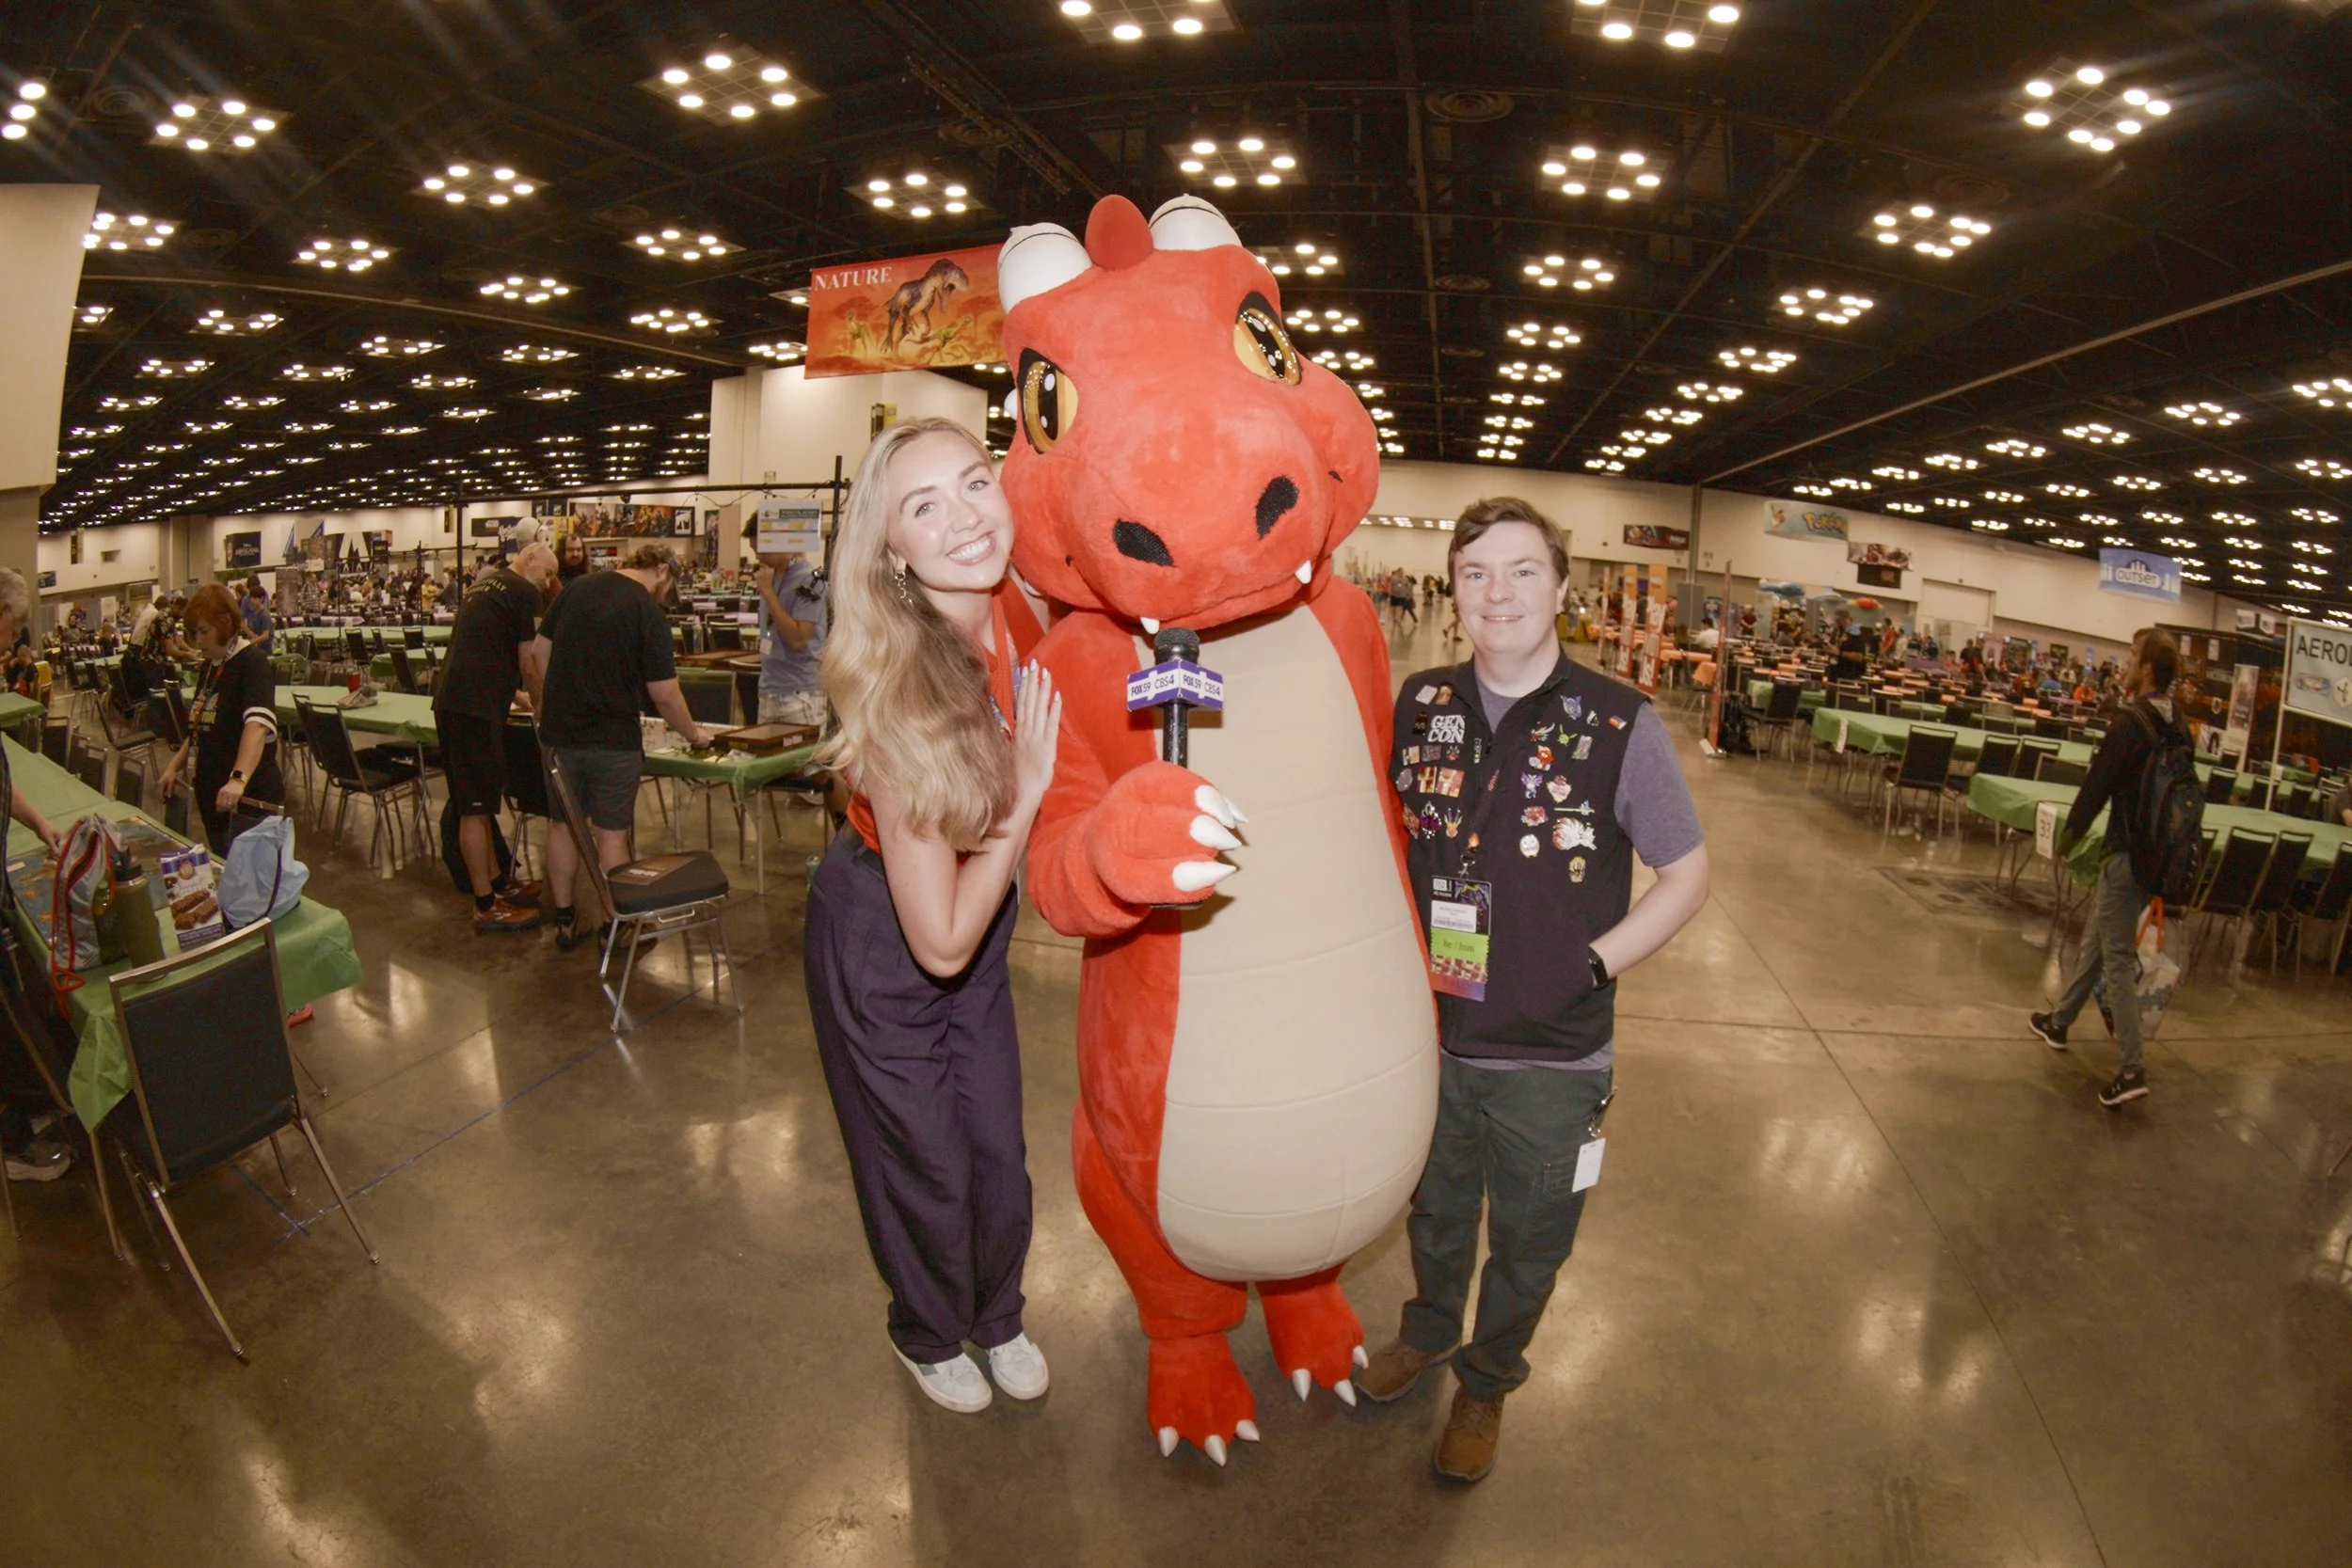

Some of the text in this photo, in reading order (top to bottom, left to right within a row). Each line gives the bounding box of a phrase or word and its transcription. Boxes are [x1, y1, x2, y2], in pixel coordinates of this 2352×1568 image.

[814, 266, 892, 291] NATURE
[2296, 635, 2352, 666] AERO
[1154, 674, 1175, 689] CBS4
[1204, 681, 1220, 696] CBS4
[1430, 714, 1465, 730] GEN
[1427, 728, 1465, 744] CON
[1442, 939, 1453, 951] he
[1458, 942, 1475, 953] him
